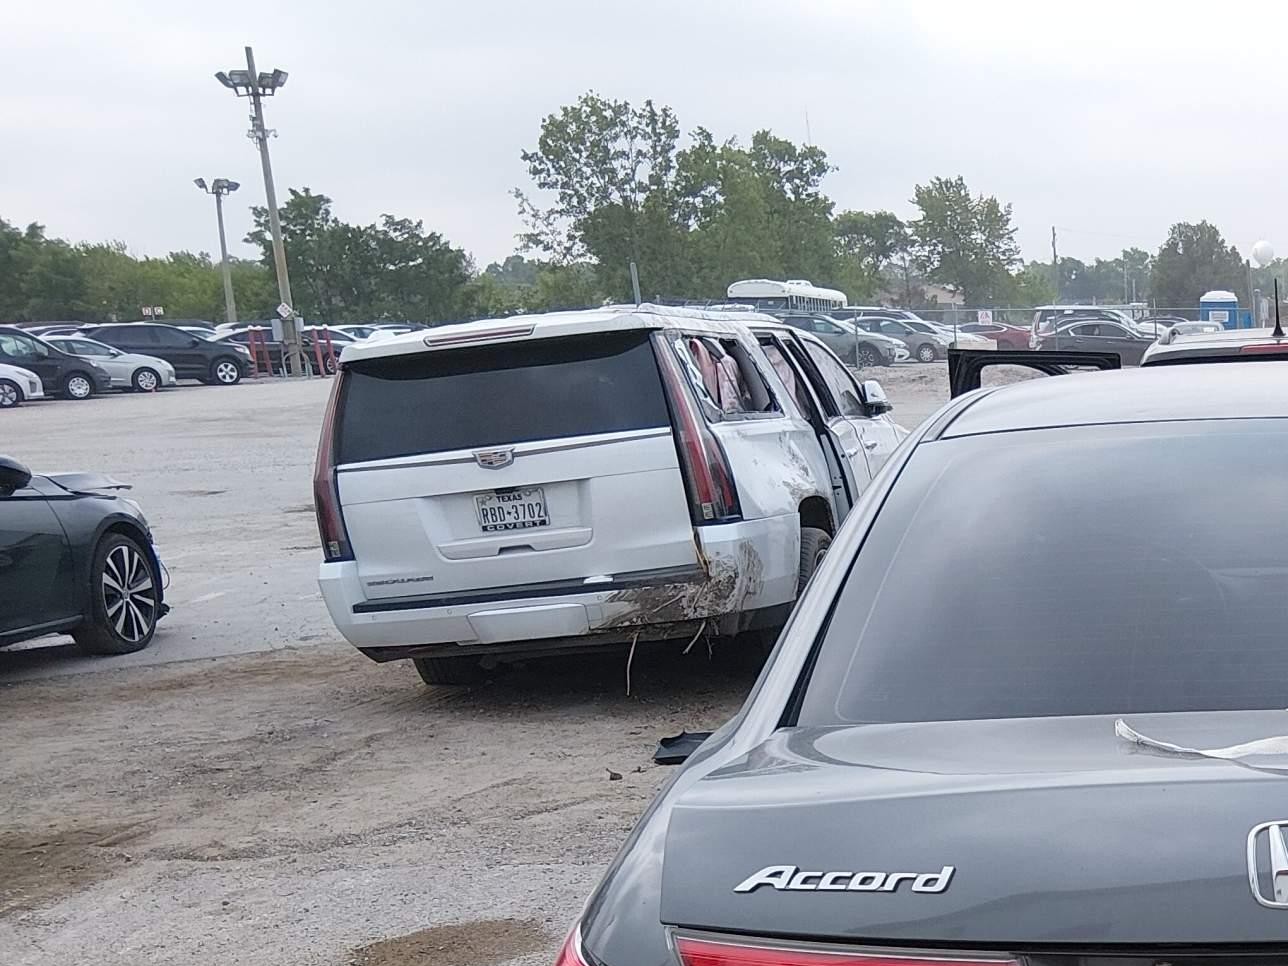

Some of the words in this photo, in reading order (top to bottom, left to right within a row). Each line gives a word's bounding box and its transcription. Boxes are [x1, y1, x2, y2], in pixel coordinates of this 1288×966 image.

[496, 493, 523, 503] TEXAS
[486, 520, 542, 532] COVERT
[733, 865, 956, 893] Accord
